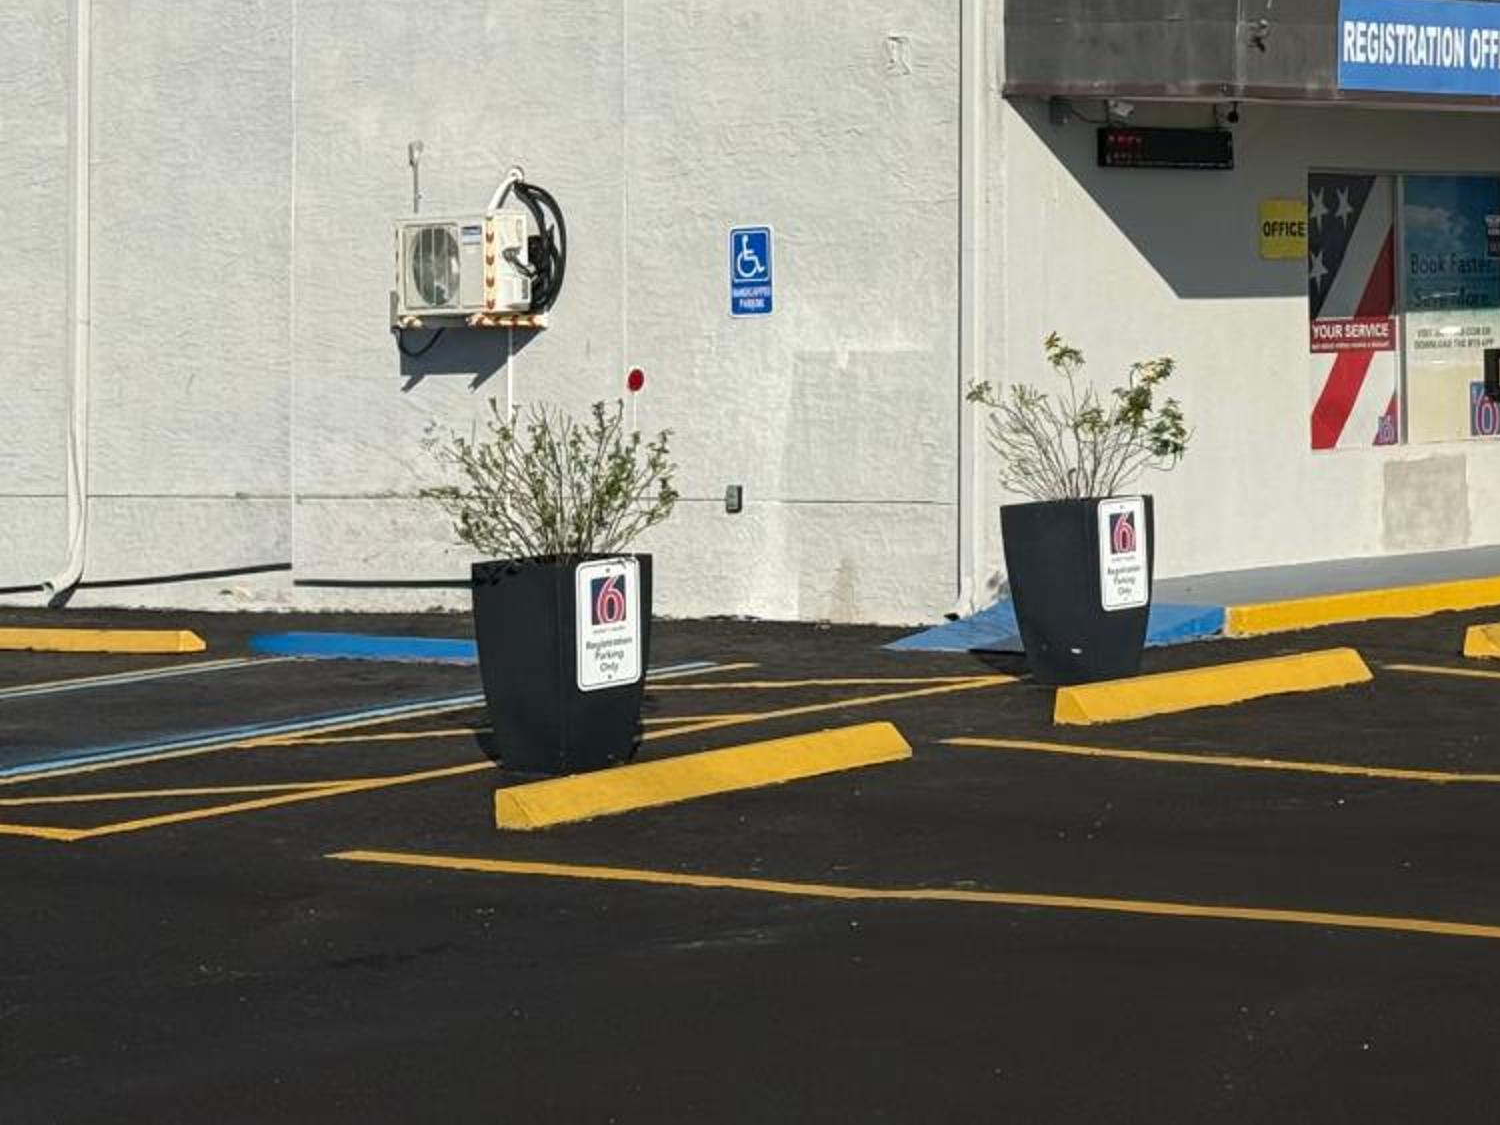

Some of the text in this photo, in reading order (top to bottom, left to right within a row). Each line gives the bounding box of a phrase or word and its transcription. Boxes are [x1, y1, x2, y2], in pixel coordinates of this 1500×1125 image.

[1343, 21, 1464, 67] REGISTRATION
[1263, 220, 1305, 237] OFFICE
[1410, 253, 1446, 274] Book
[1312, 323, 1390, 339] YOUR SERVICE
[1114, 512, 1136, 553] 6
[597, 575, 624, 625] 6
[595, 650, 624, 661] Parking
[600, 662, 619, 673] Only
